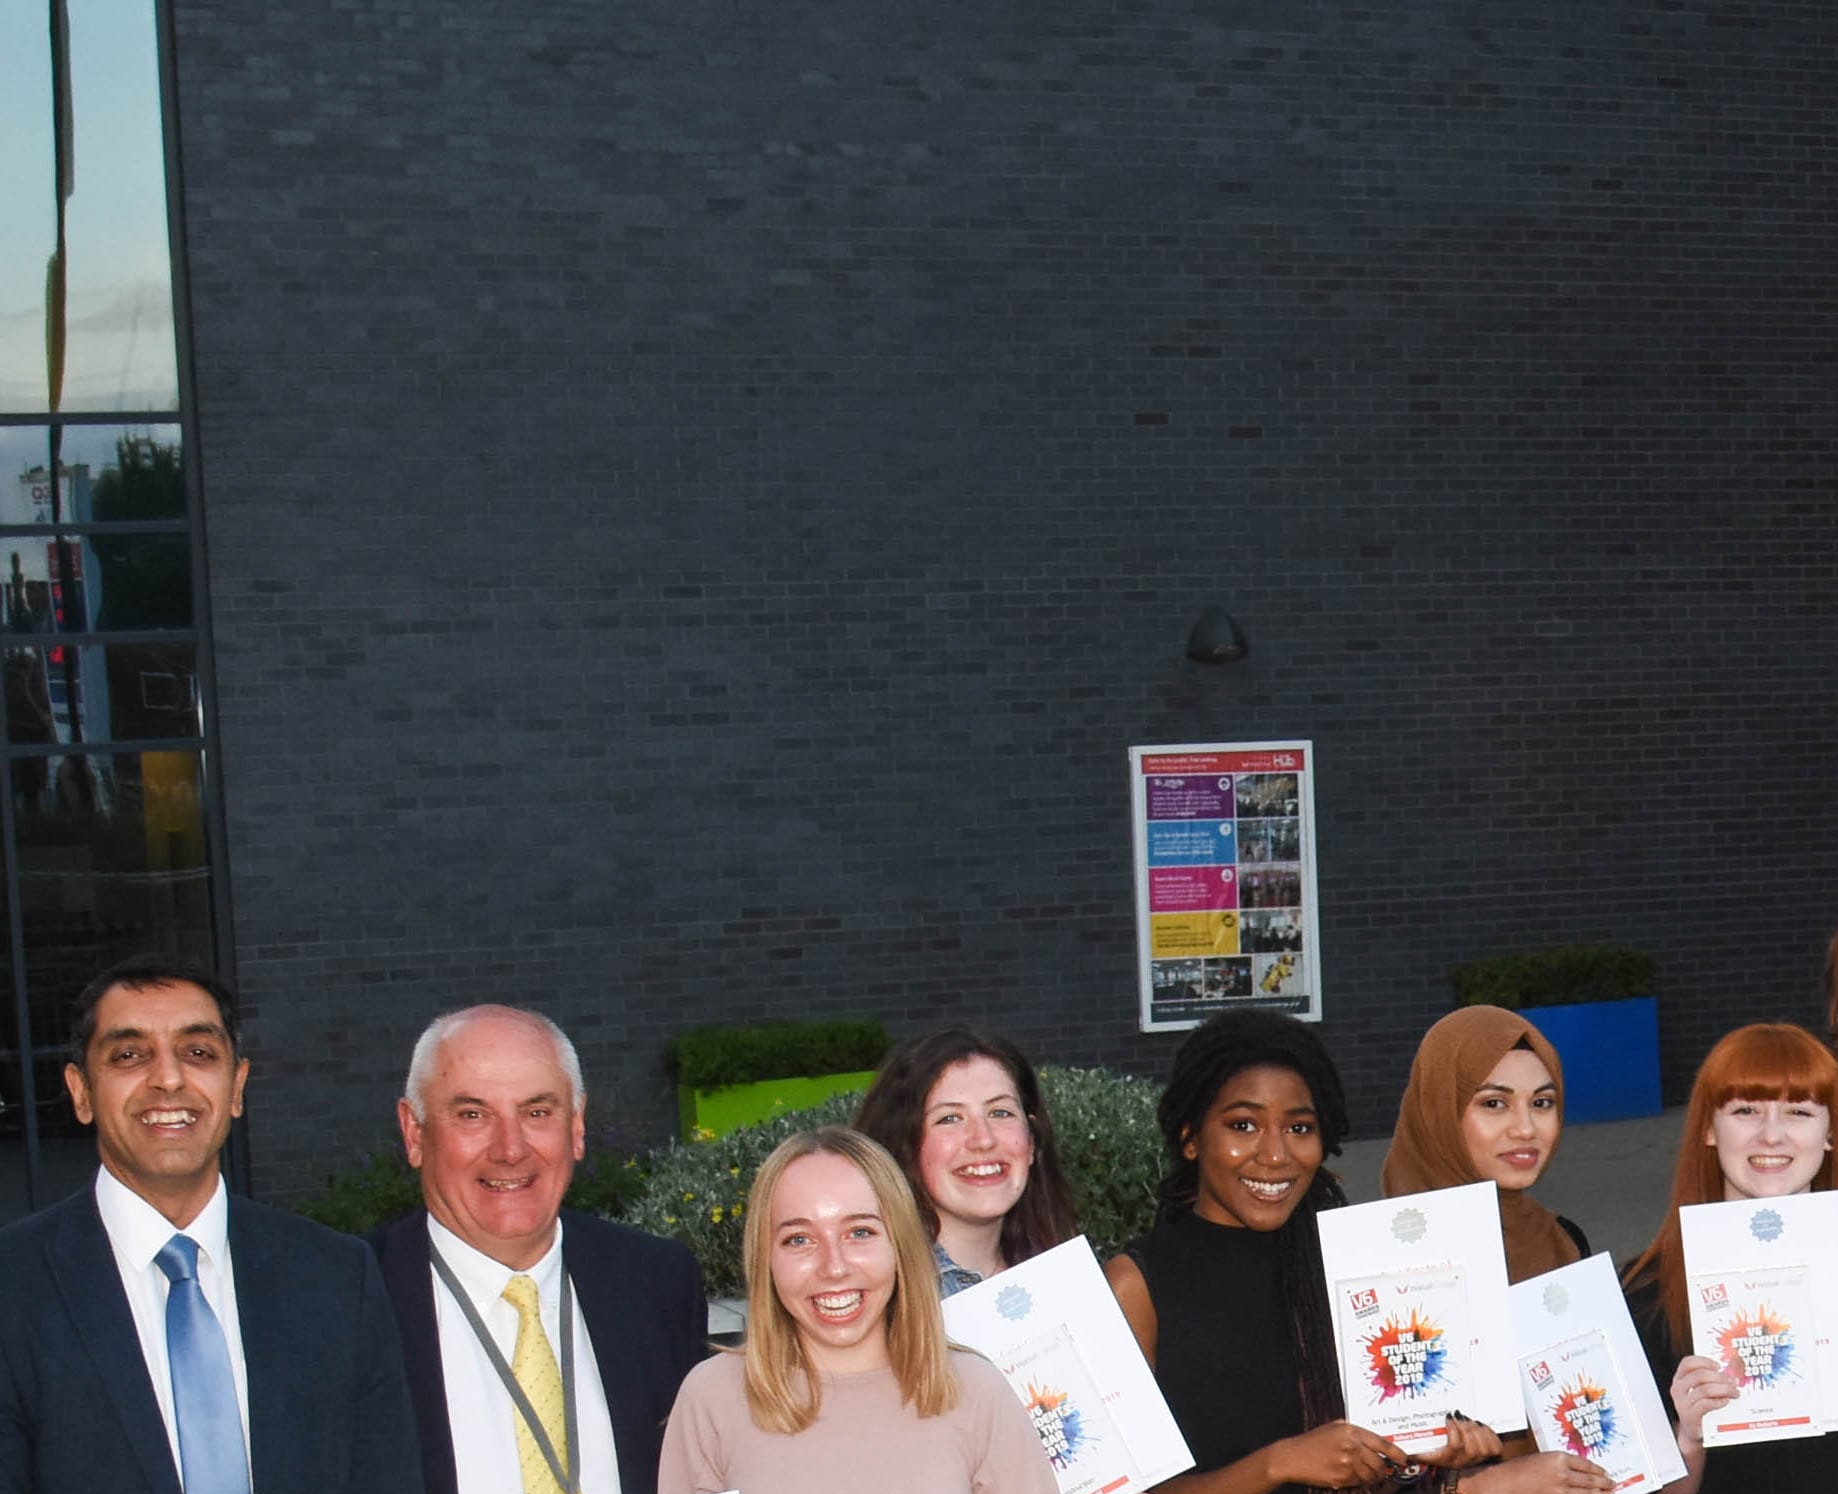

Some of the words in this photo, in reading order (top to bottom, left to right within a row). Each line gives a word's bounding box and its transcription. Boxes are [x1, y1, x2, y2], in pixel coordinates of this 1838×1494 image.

[1351, 1289, 1376, 1310] V6
[1701, 1286, 1725, 1304] V6
[1047, 1441, 1069, 1458] 019
